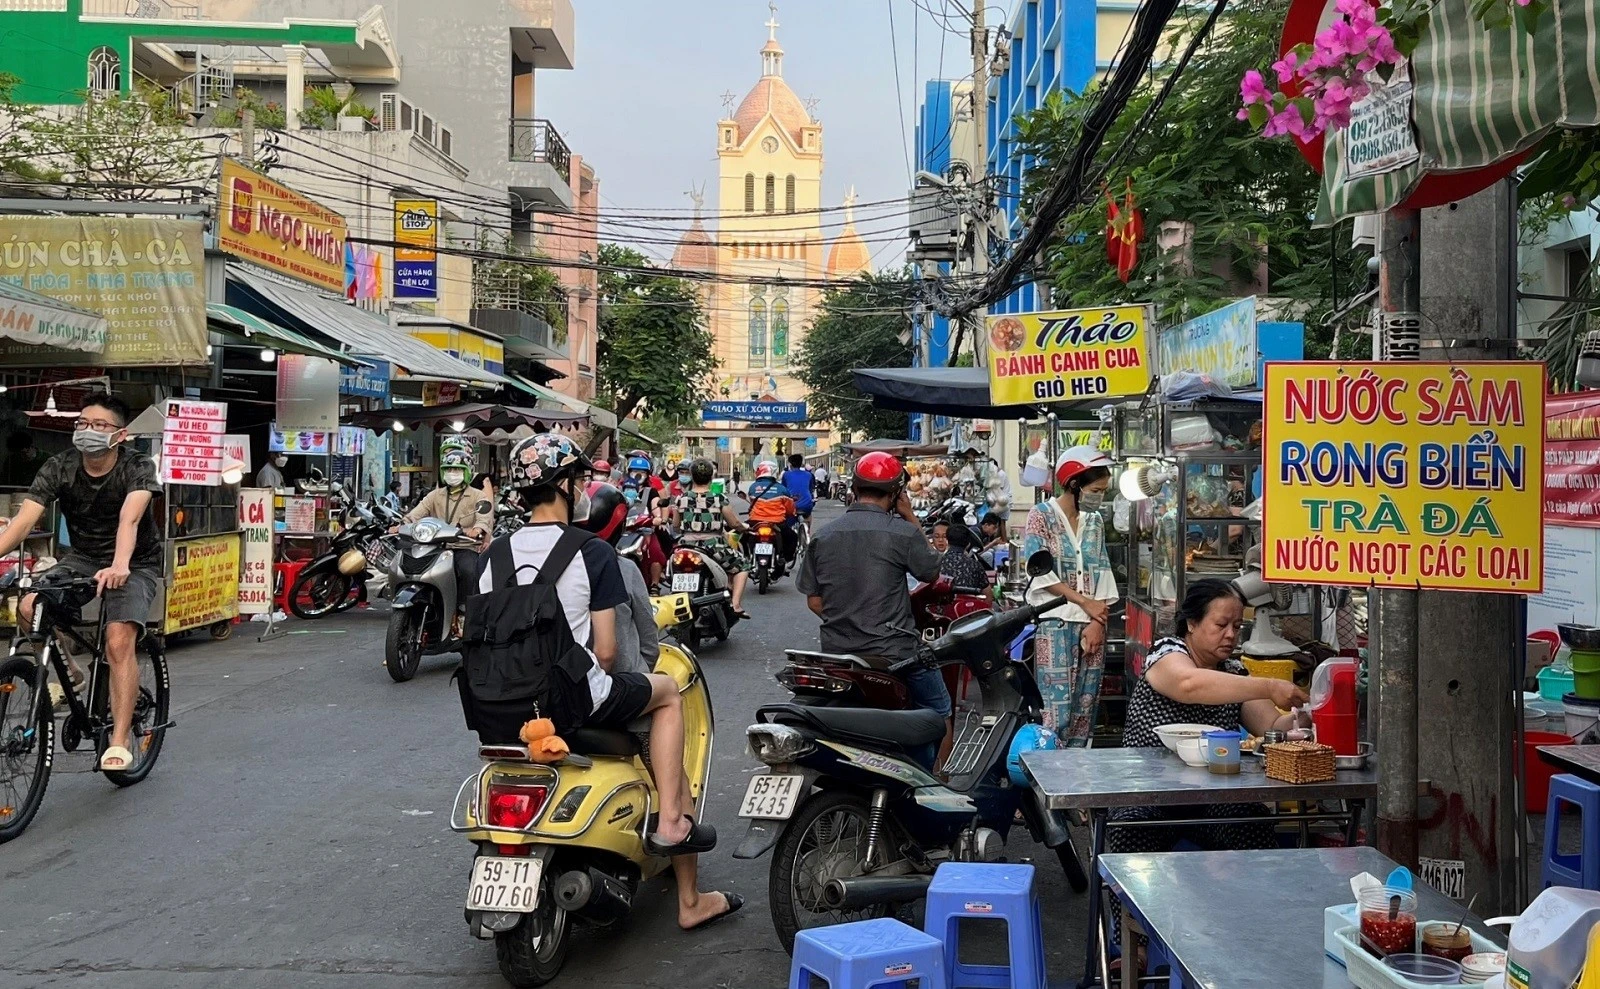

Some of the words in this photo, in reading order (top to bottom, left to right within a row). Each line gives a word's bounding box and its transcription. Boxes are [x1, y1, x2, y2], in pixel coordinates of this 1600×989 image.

[256, 201, 303, 252] NGỌC
[406, 220, 427, 228] STOP
[0, 234, 50, 269] ÚN
[132, 271, 195, 289] TRANG
[413, 267, 433, 276] HÀNG
[1035, 312, 1138, 350] Thảo
[995, 350, 1045, 378] BÁNH
[1050, 349, 1100, 374] CANH
[1105, 347, 1140, 368] CUA
[1390, 343, 1420, 361] 15
[1033, 375, 1065, 399] GIÒ
[1071, 375, 1108, 397] HEO
[1283, 368, 1408, 425] NƯỚC
[735, 403, 749, 413] XỨ
[750, 402, 771, 413] XÓM
[772, 402, 798, 414] CHIẾU
[191, 422, 208, 431] HEO
[171, 459, 186, 468] BAO
[1280, 440, 1407, 488] RONG
[1418, 430, 1525, 491] BIỂN
[182, 472, 207, 481] K/100G
[248, 499, 265, 524] CÁ
[1301, 494, 1410, 535] TRÀ
[1419, 496, 1503, 539] ĐÁ
[245, 527, 269, 543] TRANG
[255, 560, 265, 570] cá
[1275, 534, 1340, 574] NƯỚC
[1348, 540, 1412, 582] NGỌT
[1418, 538, 1467, 579] CÁC
[1476, 545, 1530, 587] LOẠI
[255, 573, 265, 584] cá
[45, 722, 54, 767] MAXXIS
[753, 776, 793, 794] 65-FA
[746, 796, 786, 816] 5435
[483, 861, 529, 883] 59-T1
[473, 884, 533, 907] 007.60
